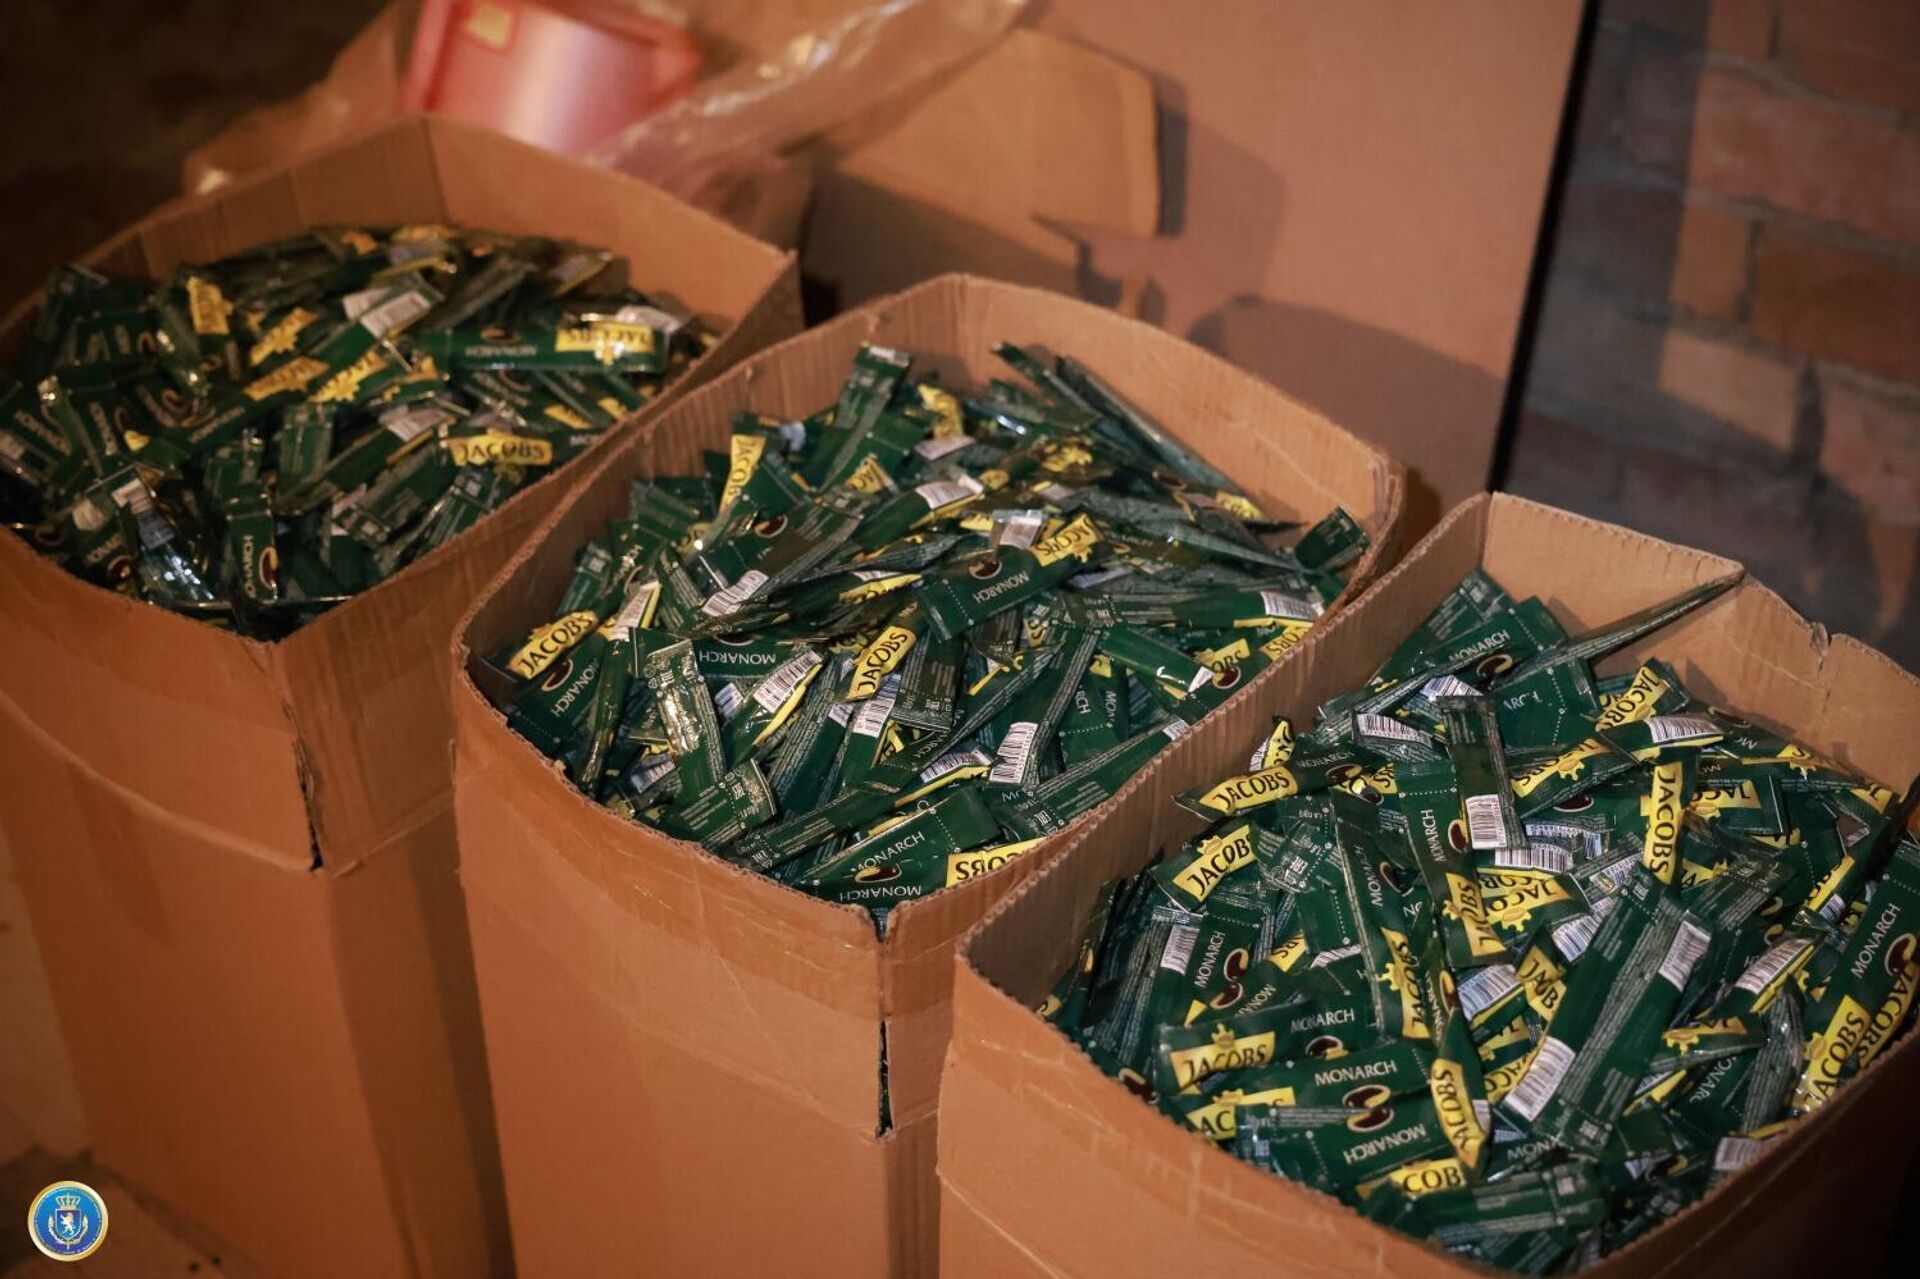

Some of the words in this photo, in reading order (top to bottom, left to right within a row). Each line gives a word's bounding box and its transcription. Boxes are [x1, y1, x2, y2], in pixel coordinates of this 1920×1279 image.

[973, 572, 1030, 604] MONARCH
[518, 613, 594, 677] JACOBS
[699, 650, 777, 665] MONARCH
[857, 631, 908, 692] JACOBS
[1211, 770, 1291, 810] JACOBS
[1652, 771, 1676, 874] JACOBS
[839, 885, 922, 902] MONARCH
[1193, 931, 1226, 989] MONARCH
[1850, 902, 1902, 980] MONARCH
[1314, 1060, 1398, 1087] MONARCH
[1342, 1123, 1427, 1165] MONARCH
[1402, 1164, 1461, 1194] COB
